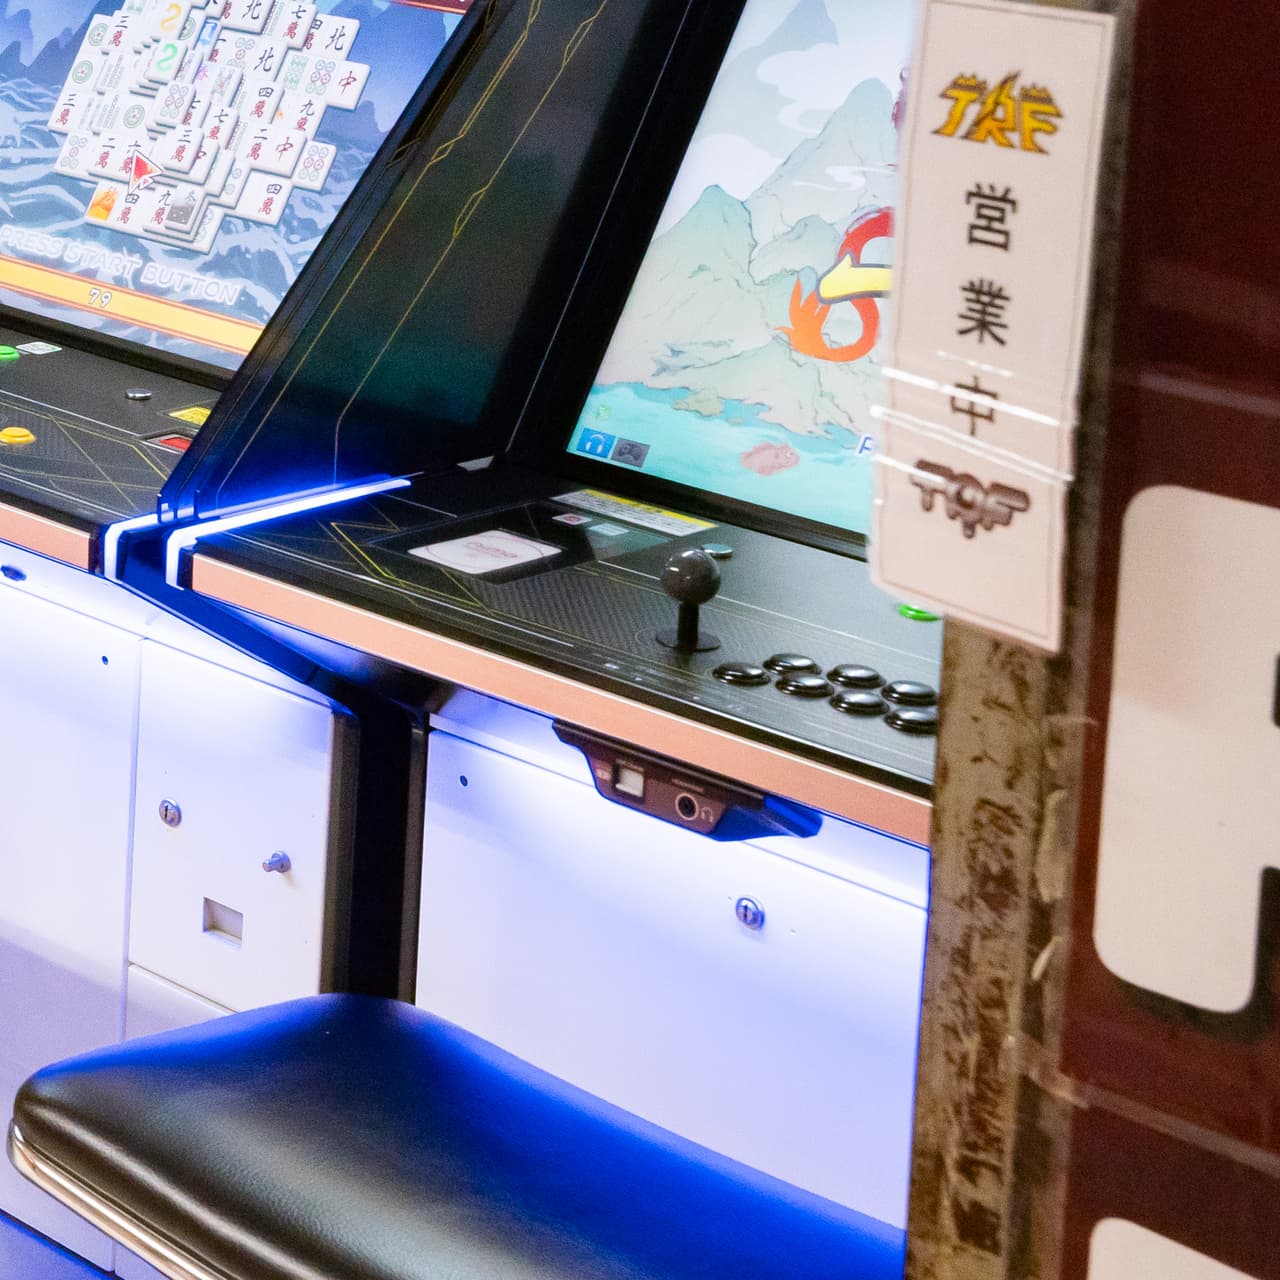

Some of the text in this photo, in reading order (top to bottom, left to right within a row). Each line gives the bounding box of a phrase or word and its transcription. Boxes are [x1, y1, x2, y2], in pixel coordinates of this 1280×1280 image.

[64, 241, 143, 278] START
[141, 262, 239, 306] BUTTON
[89, 288, 112, 308] 79
[950, 181, 1019, 437] 営業中
